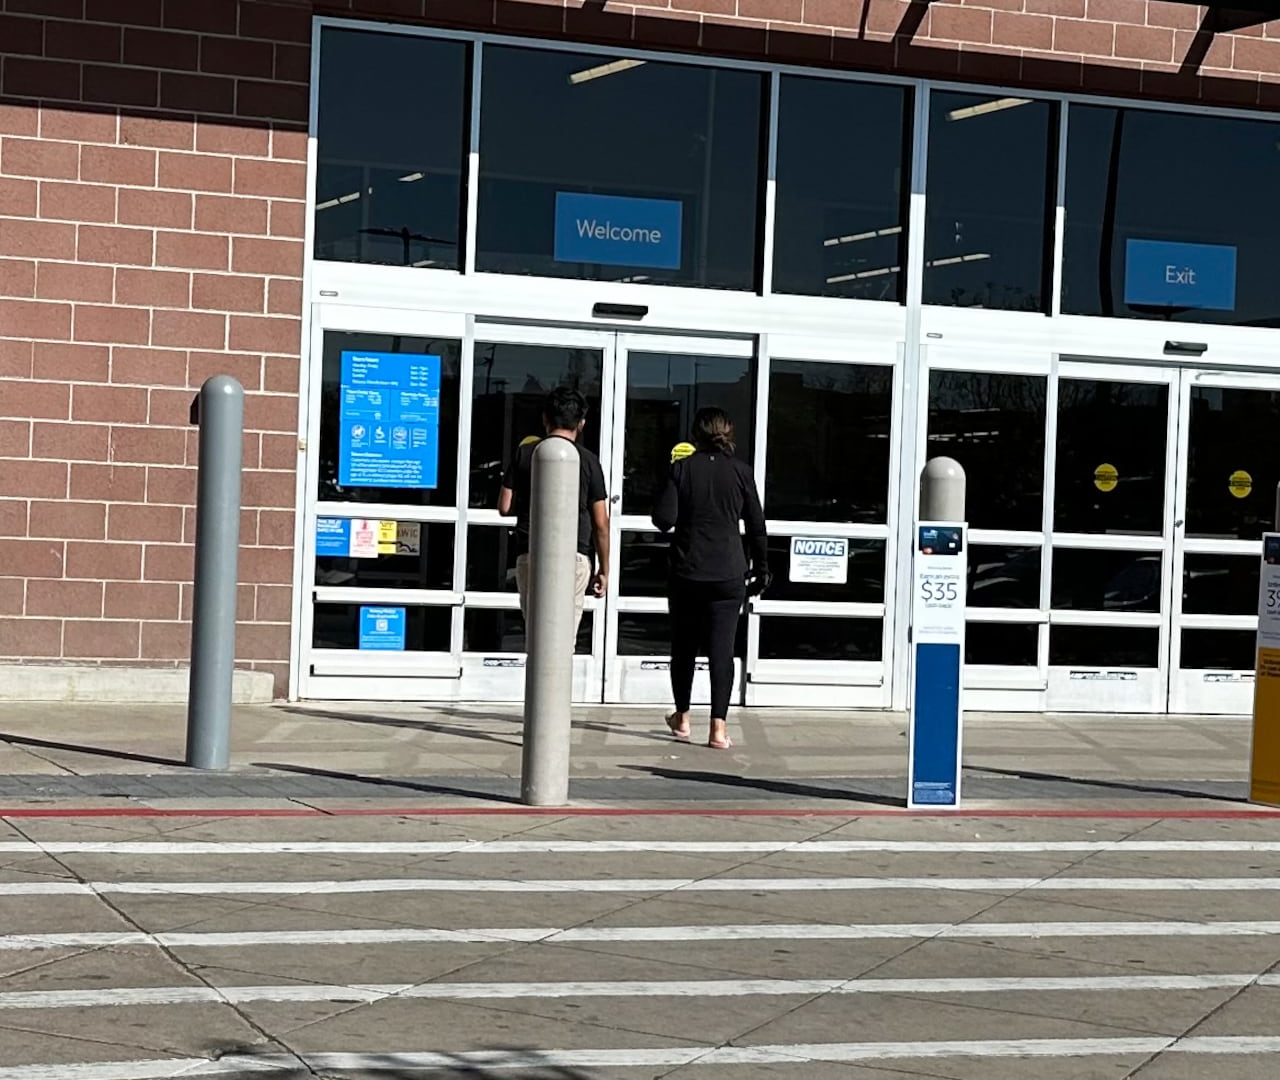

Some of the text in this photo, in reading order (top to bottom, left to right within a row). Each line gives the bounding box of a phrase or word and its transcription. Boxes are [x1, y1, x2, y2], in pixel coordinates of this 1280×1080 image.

[576, 218, 662, 244] Welcome
[1165, 264, 1196, 285] Exit
[794, 540, 844, 555] NOTICE
[921, 579, 958, 602] $35
